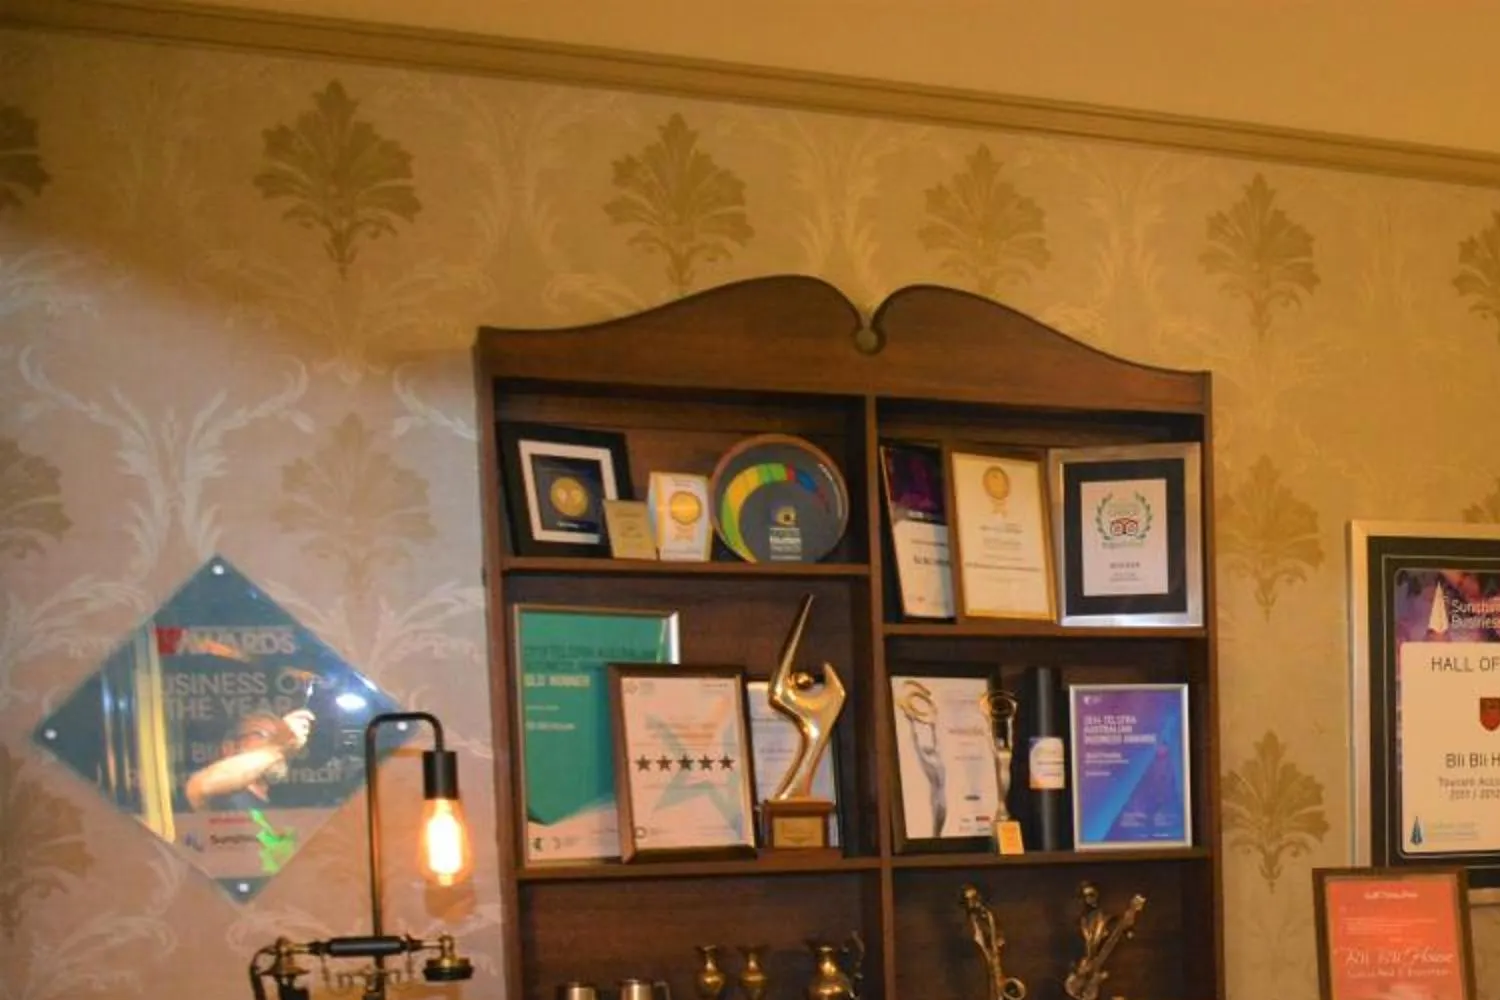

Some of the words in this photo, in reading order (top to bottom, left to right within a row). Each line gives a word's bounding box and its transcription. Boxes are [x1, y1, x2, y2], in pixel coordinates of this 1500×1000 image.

[176, 630, 296, 655] AWARDS
[1431, 656, 1474, 673] HALL
[1479, 656, 1500, 672] OF
[1445, 753, 1465, 769] Bli
[1469, 753, 1488, 768] Bli
